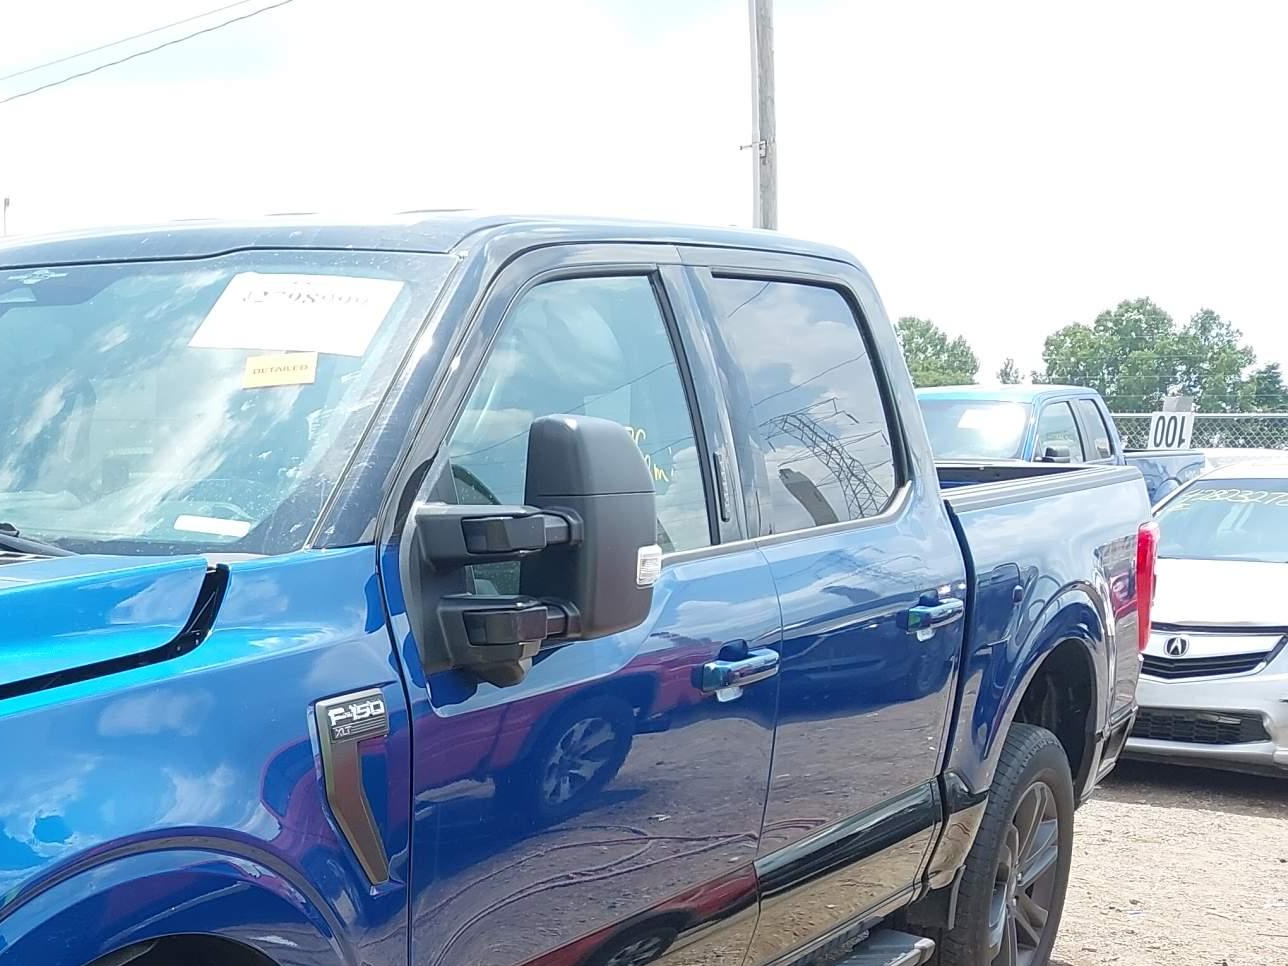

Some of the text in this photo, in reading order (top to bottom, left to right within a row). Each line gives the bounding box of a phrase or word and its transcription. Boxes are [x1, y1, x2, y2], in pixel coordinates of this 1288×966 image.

[252, 363, 309, 376] DETAILED
[1153, 415, 1187, 448] 100
[327, 700, 385, 726] F-150
[331, 724, 353, 739] XLT
